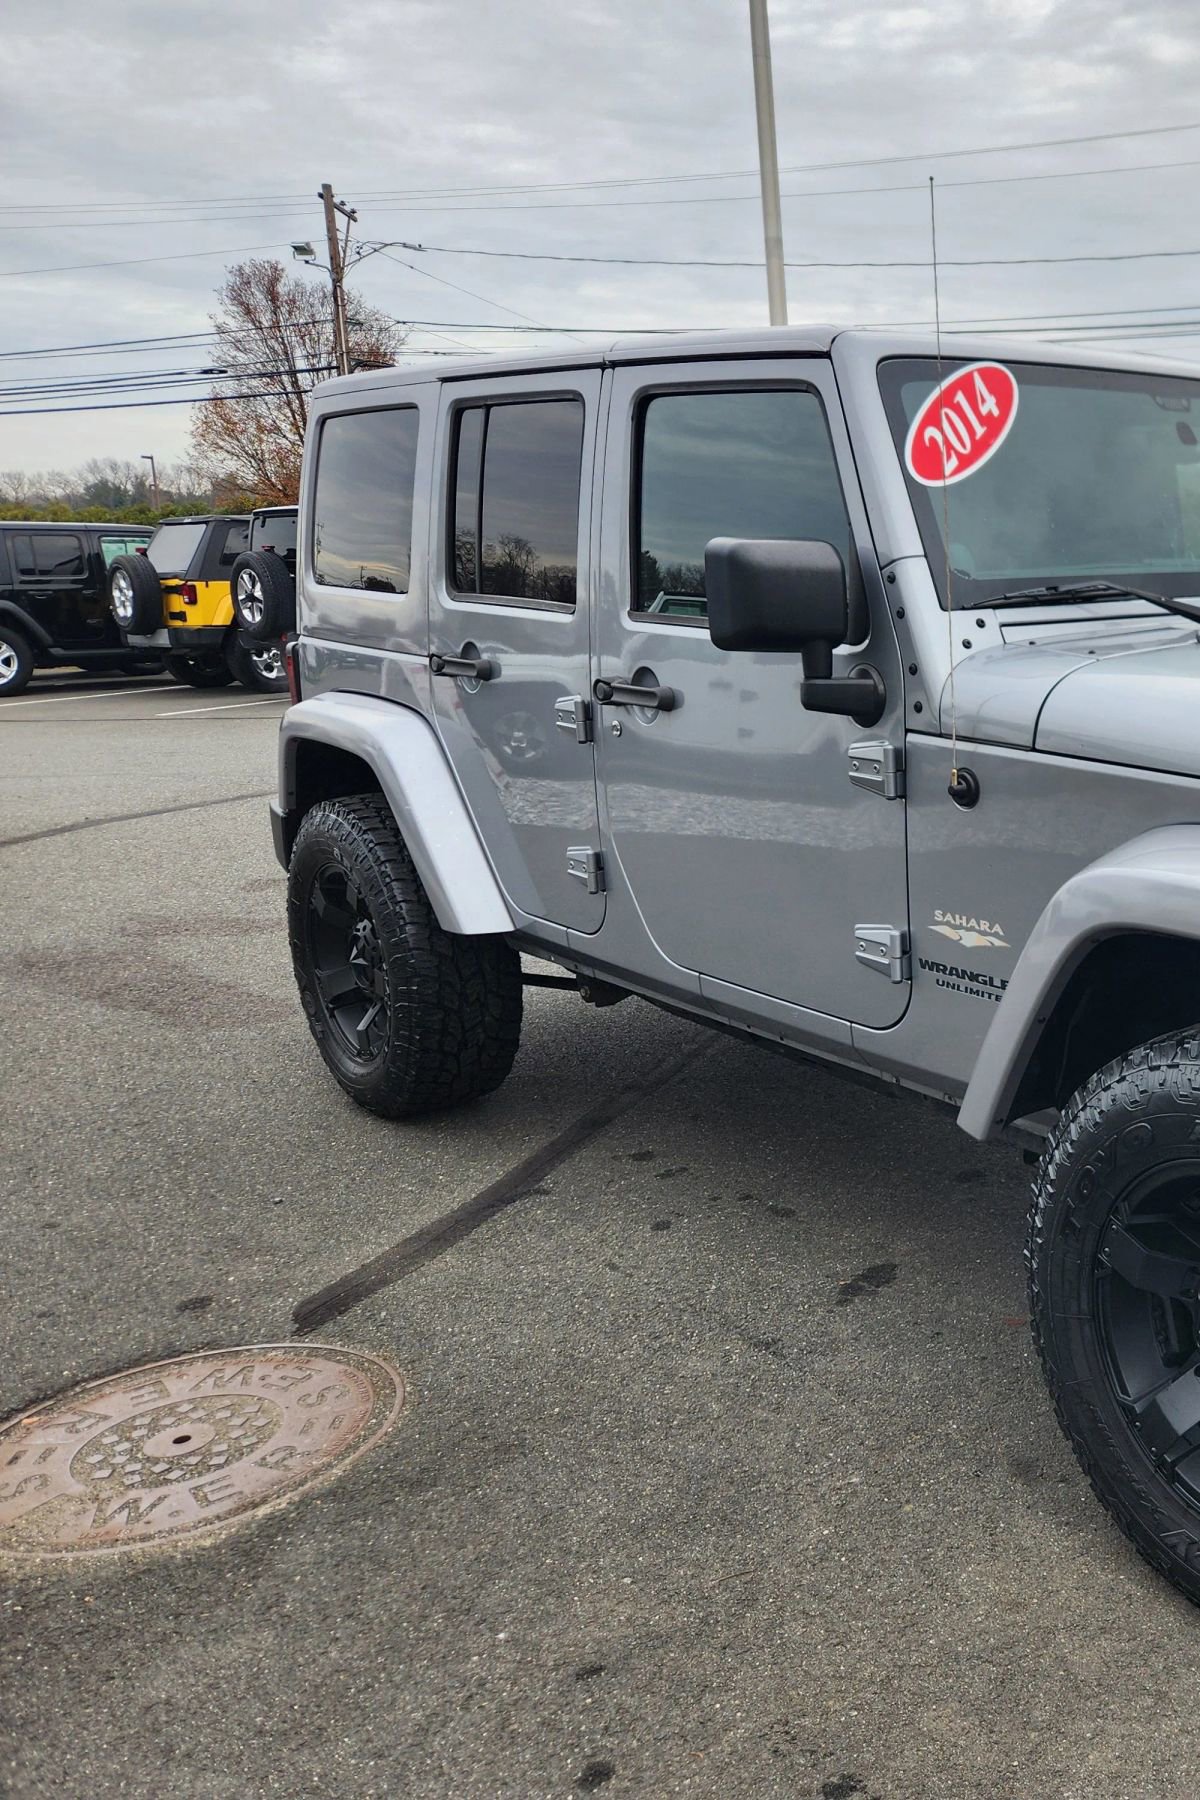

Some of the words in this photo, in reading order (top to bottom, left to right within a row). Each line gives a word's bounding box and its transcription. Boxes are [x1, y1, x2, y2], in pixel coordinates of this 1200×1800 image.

[923, 370, 1000, 477] 2014
[934, 909, 1005, 936] SAHARA
[918, 957, 1009, 991] WRANGLE
[936, 978, 1004, 1003] UNLIMITE
